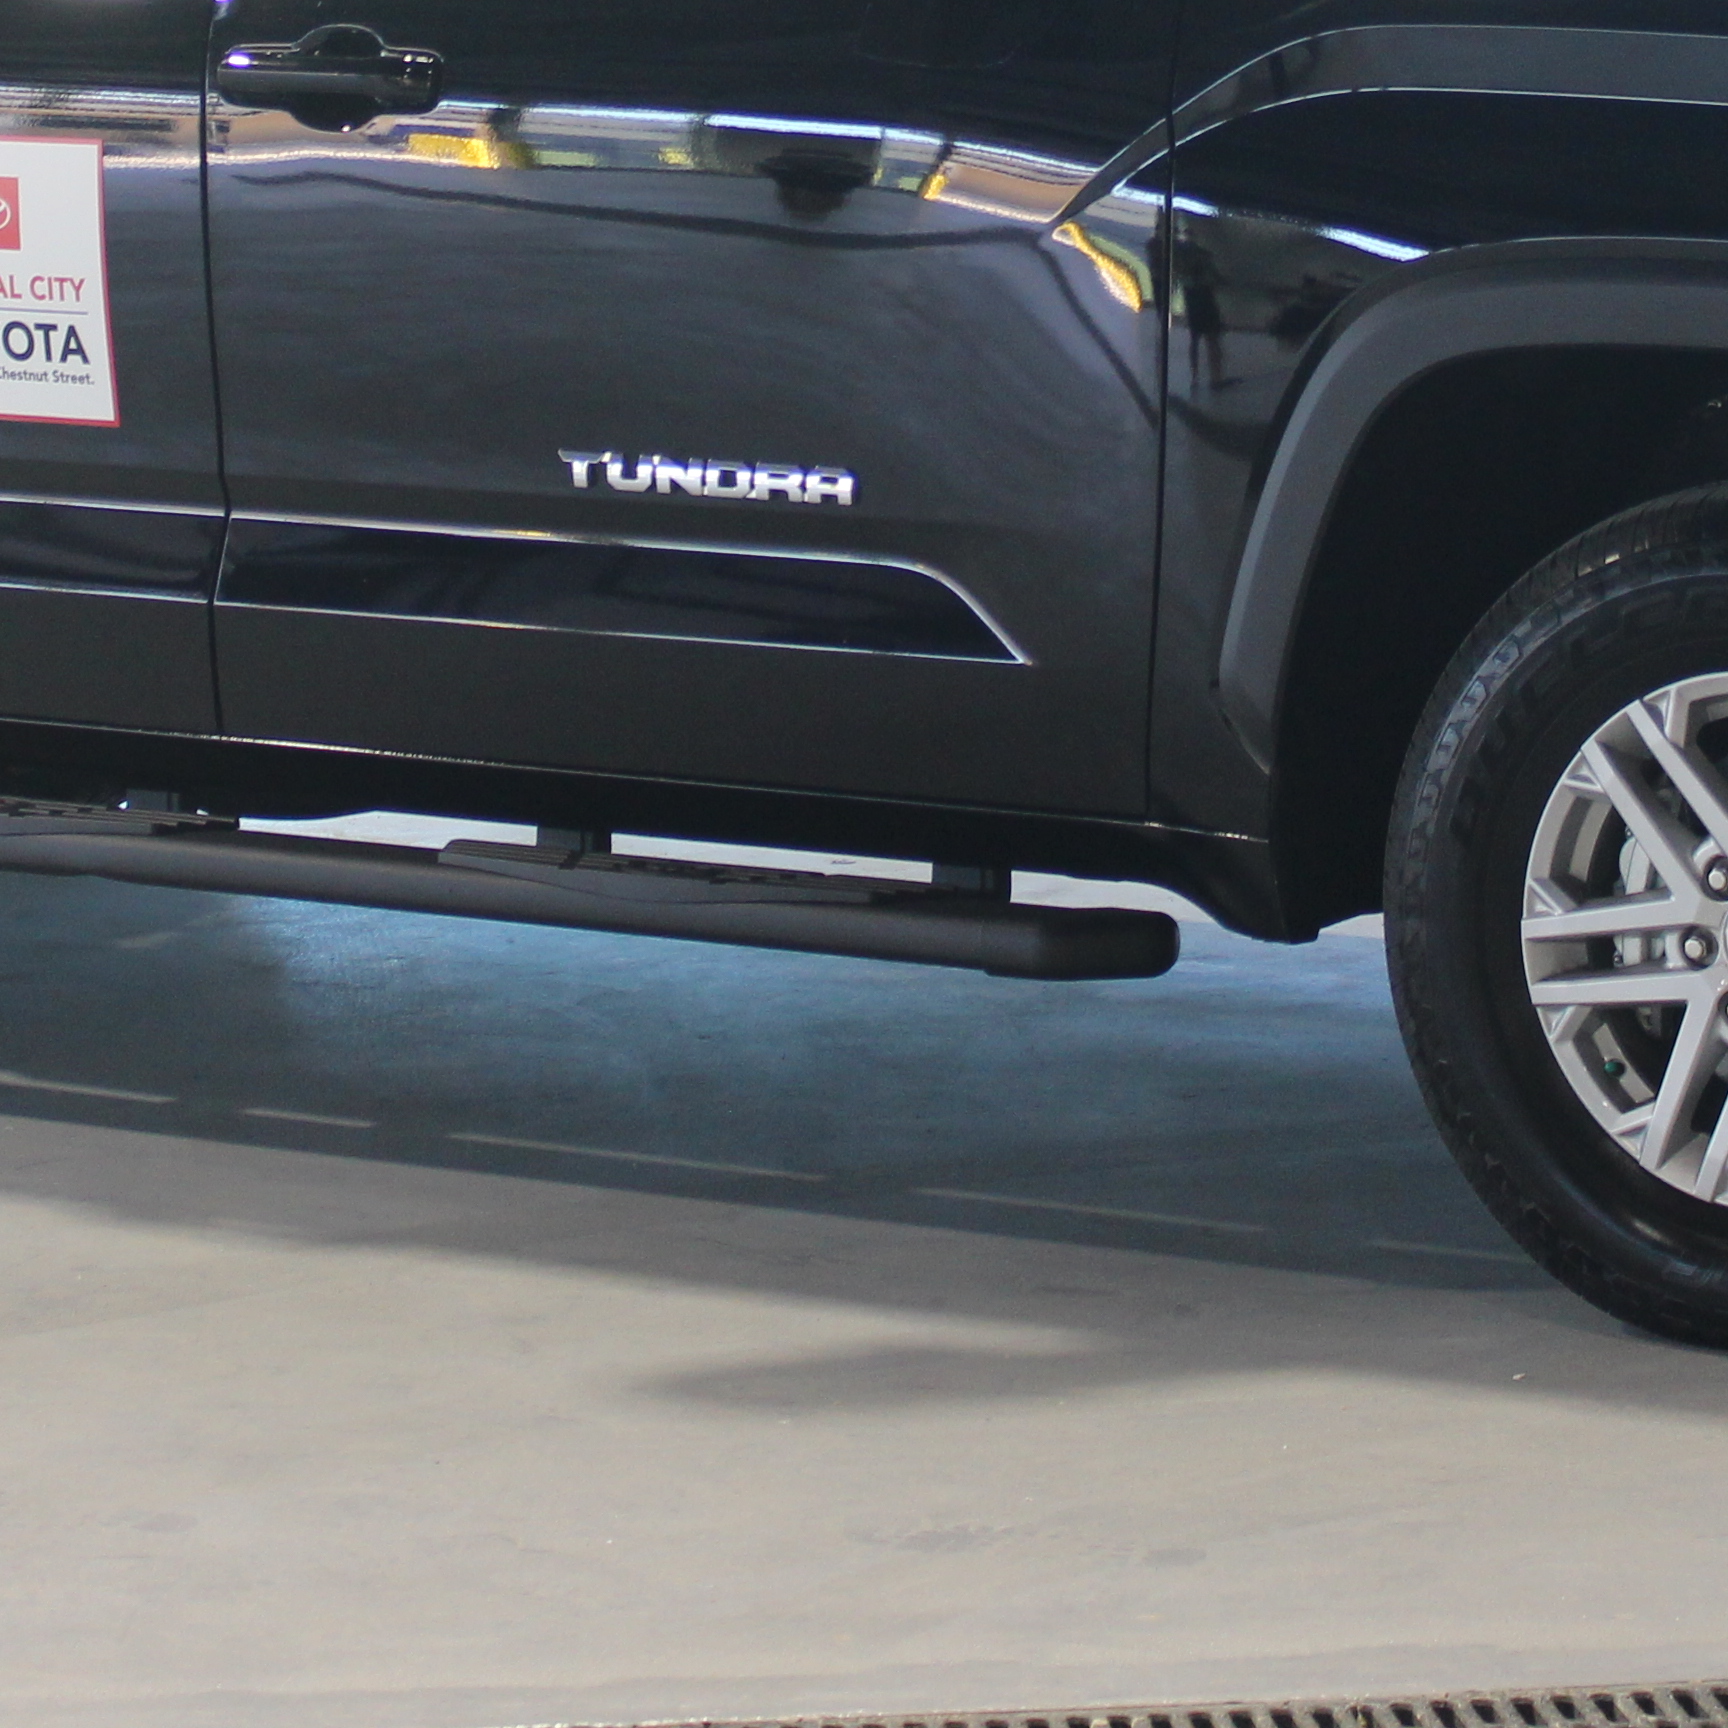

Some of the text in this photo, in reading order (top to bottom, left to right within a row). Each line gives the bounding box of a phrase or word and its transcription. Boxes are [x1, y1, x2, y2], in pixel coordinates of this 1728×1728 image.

[29, 275, 86, 303] CITY
[52, 370, 95, 386] Street.
[558, 448, 855, 506] TUNDRA
